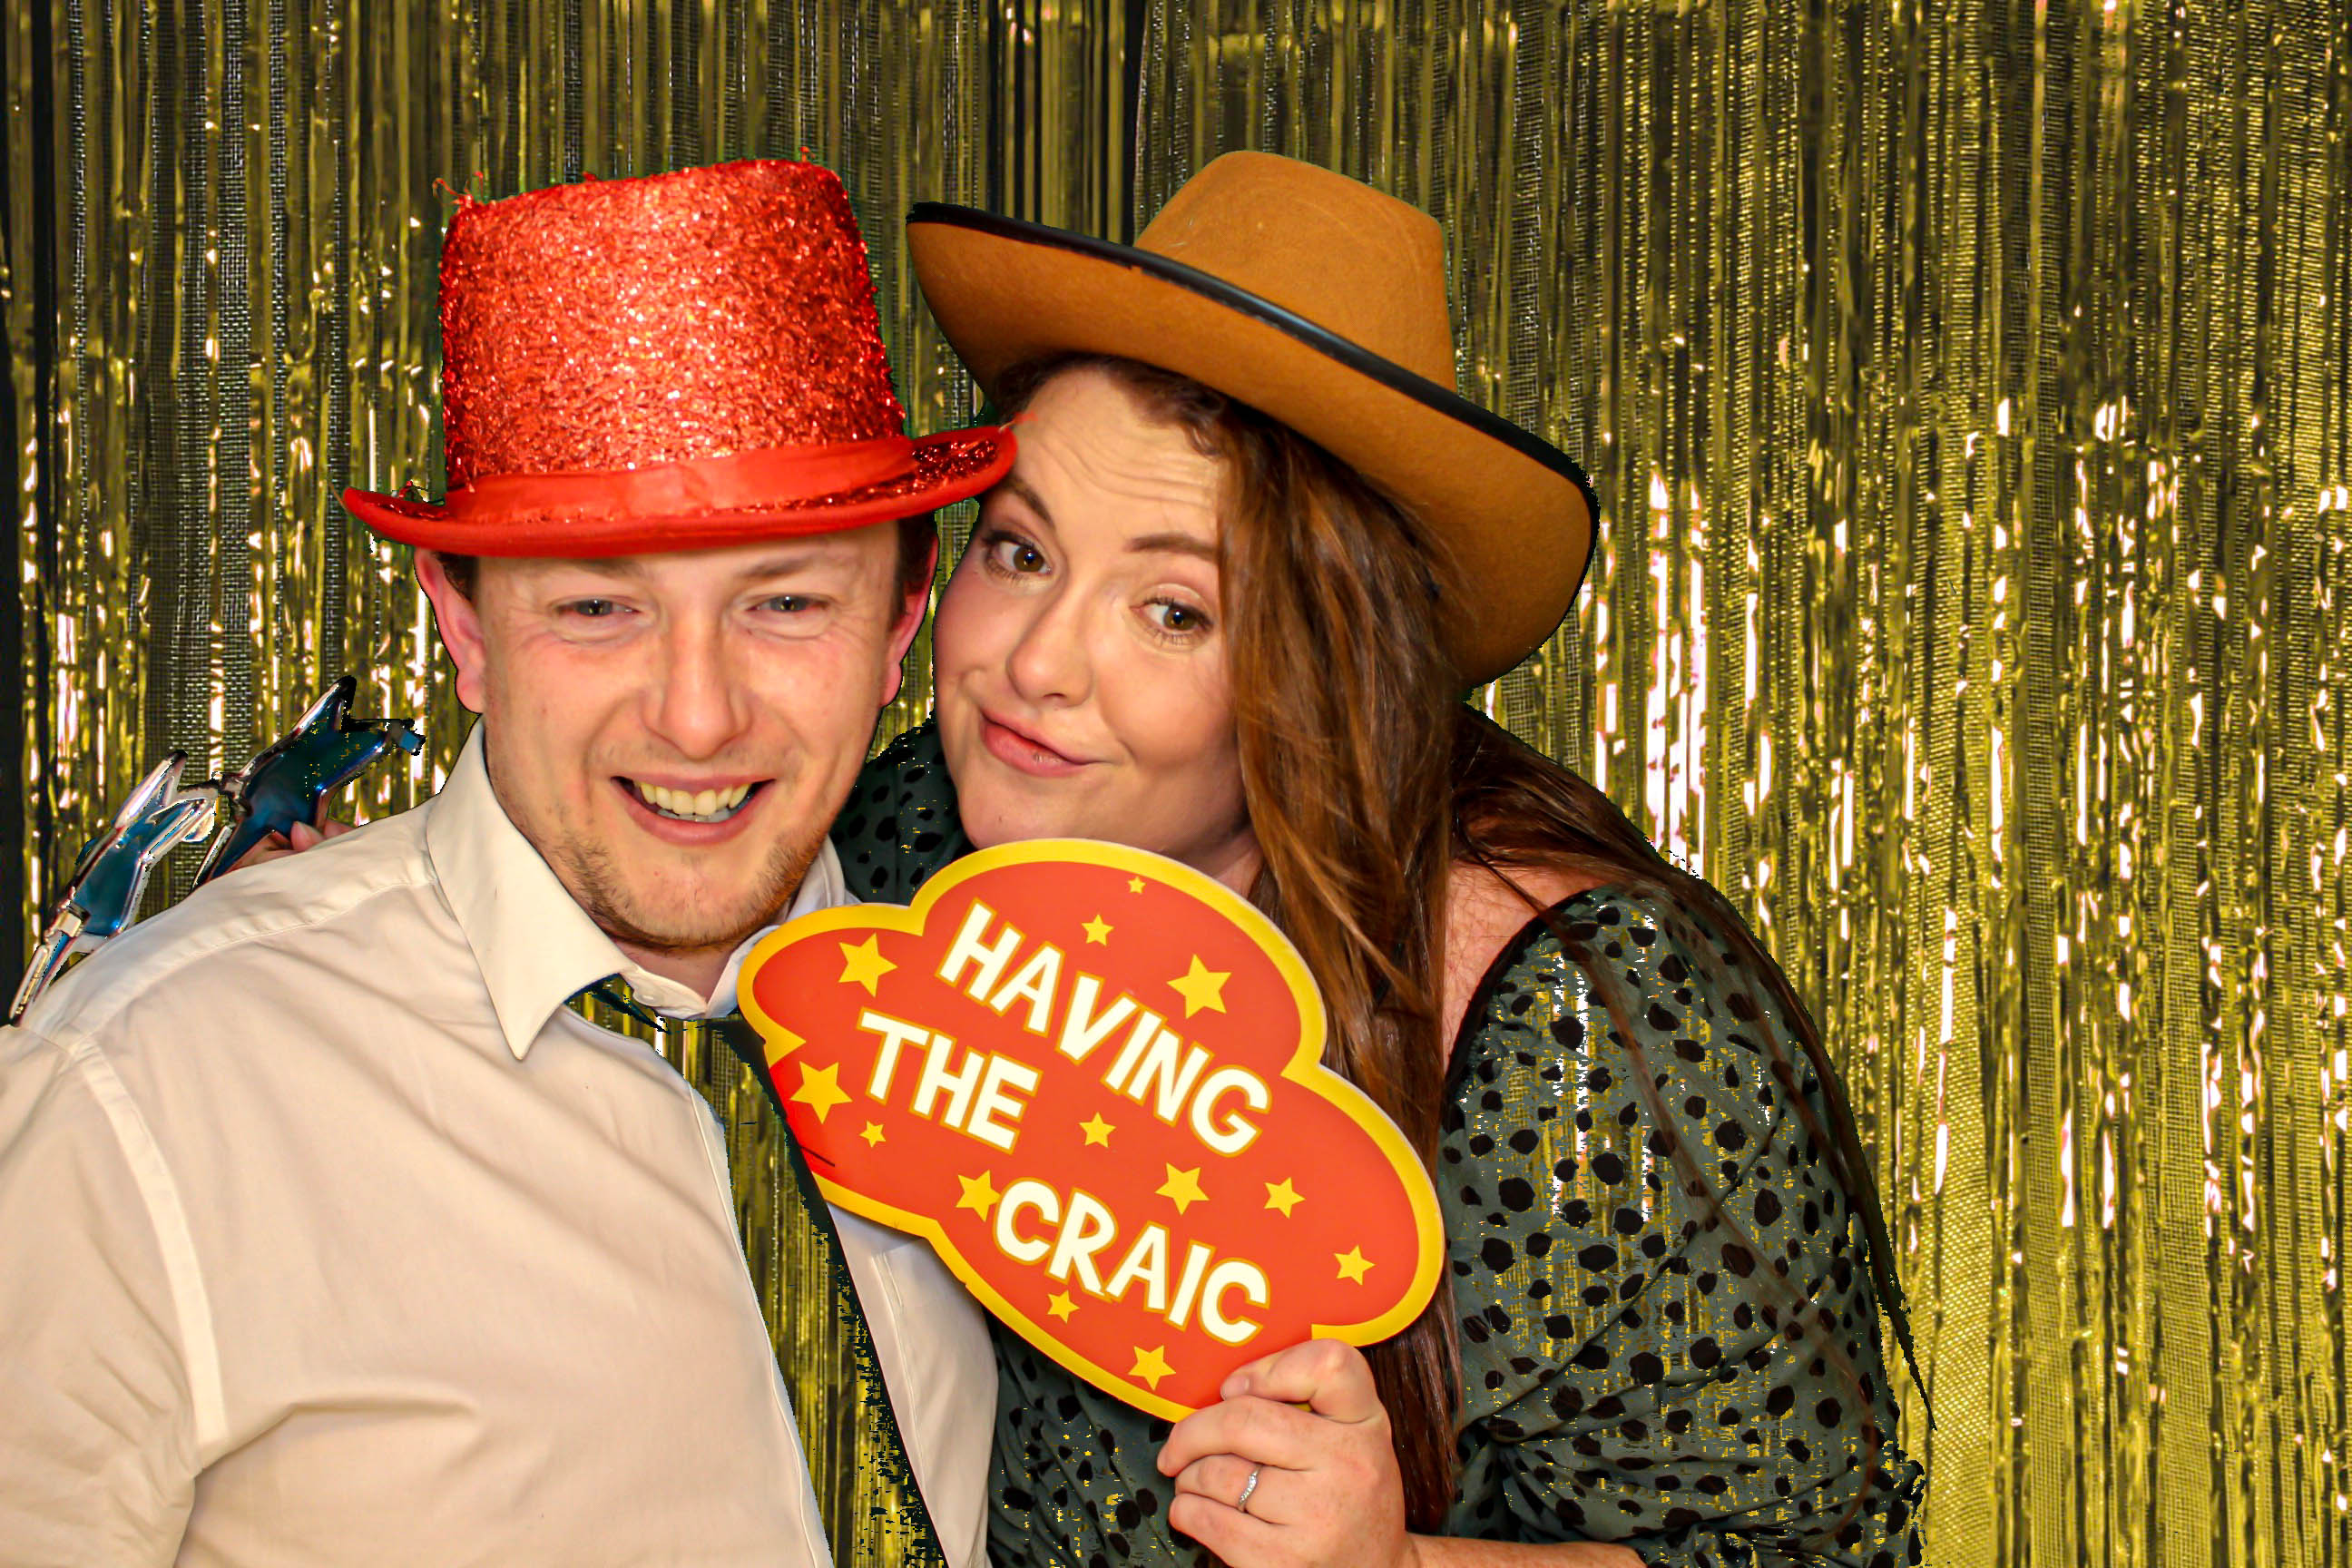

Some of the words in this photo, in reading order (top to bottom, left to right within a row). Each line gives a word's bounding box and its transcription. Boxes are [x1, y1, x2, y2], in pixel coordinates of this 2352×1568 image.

[858, 1009, 1040, 1152] THE
[937, 901, 1270, 1156] HAVING
[995, 1179, 1268, 1344] CRAIC
